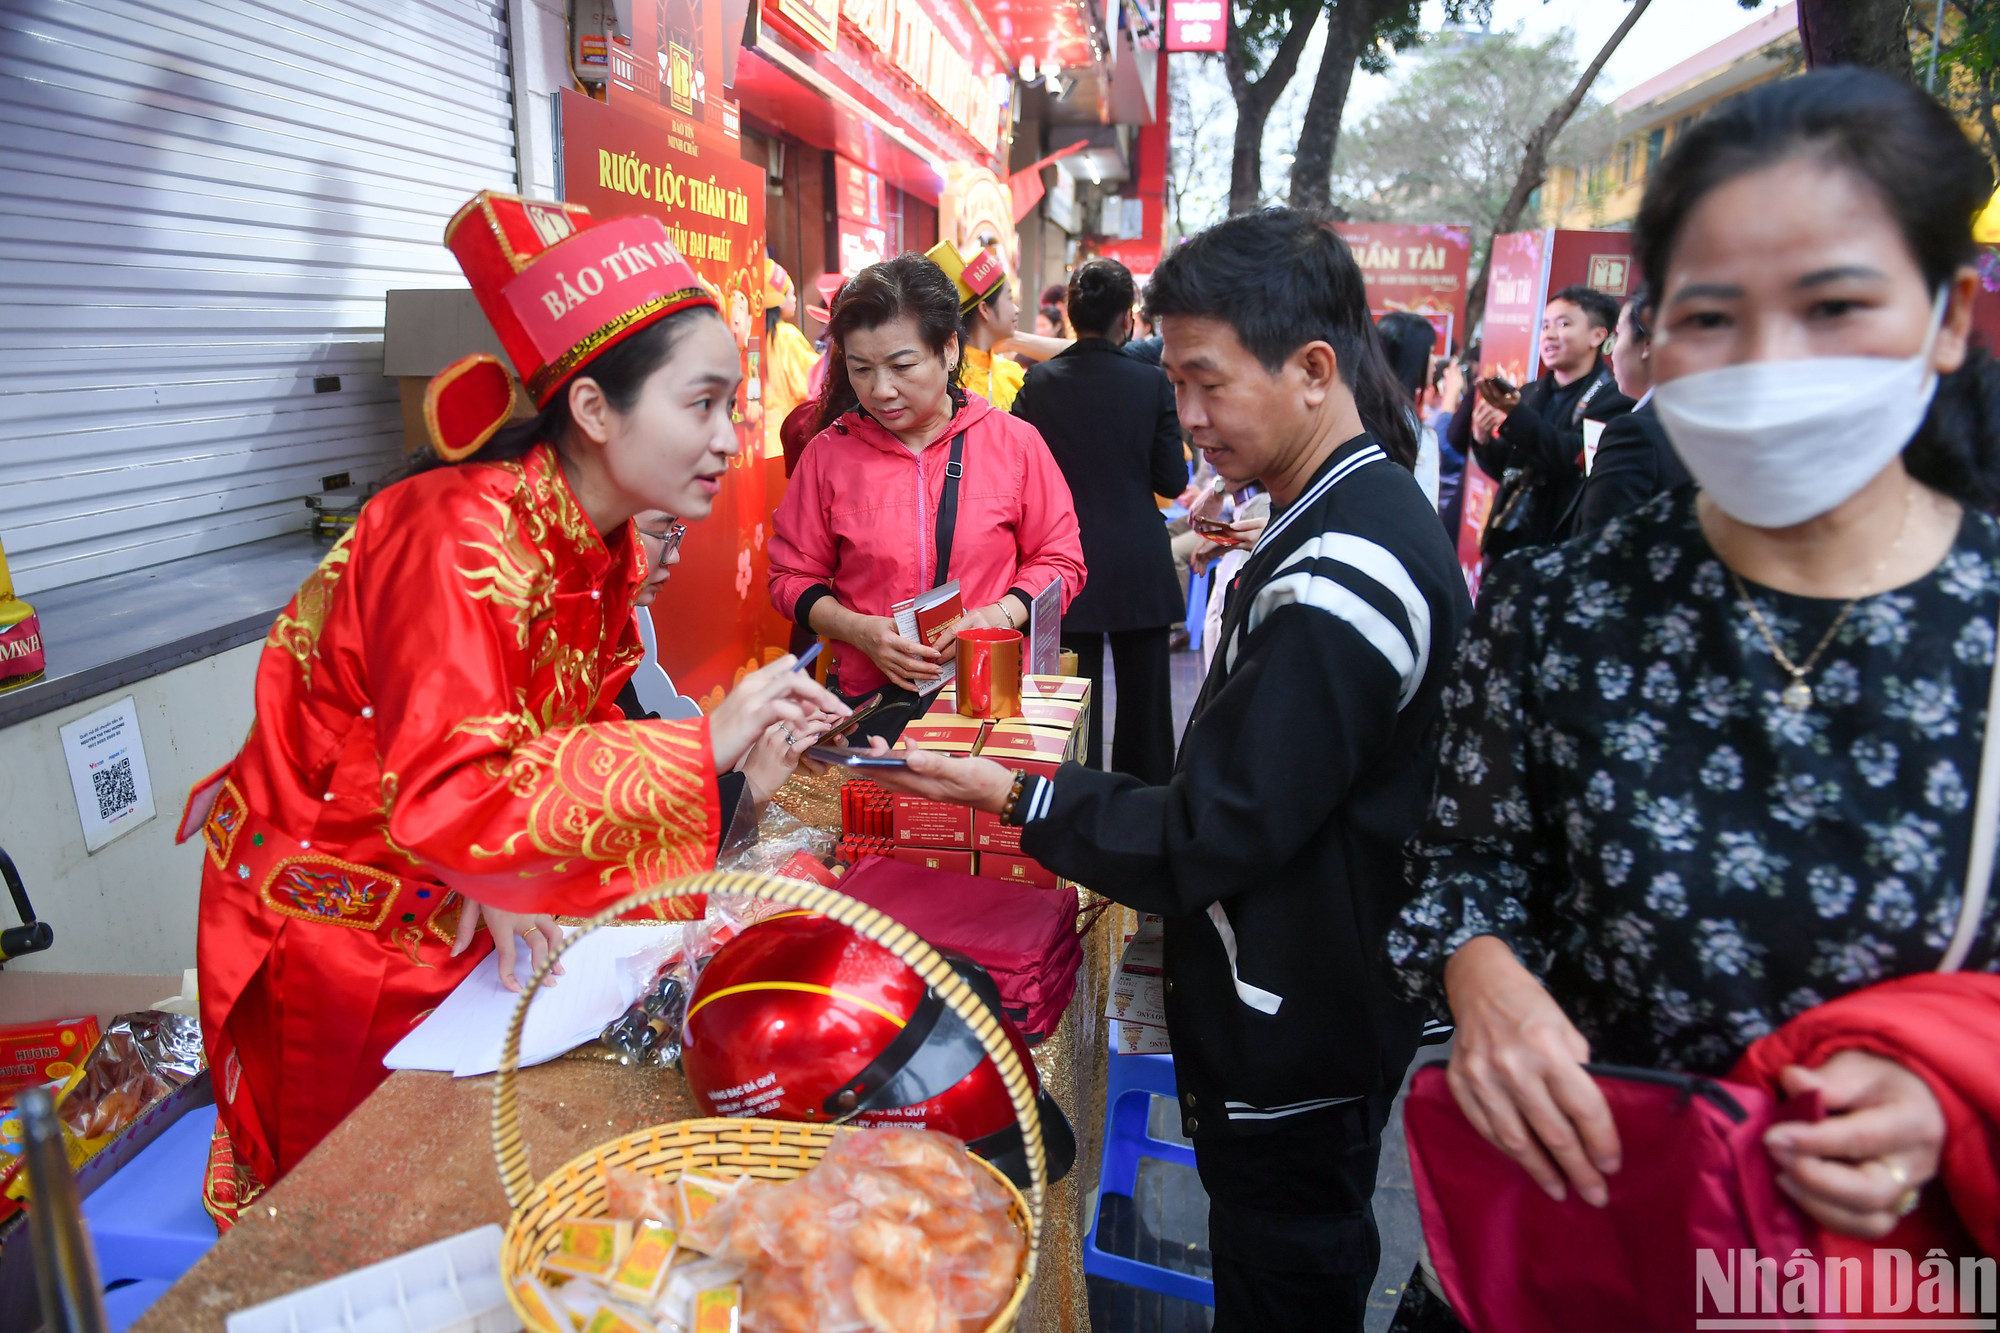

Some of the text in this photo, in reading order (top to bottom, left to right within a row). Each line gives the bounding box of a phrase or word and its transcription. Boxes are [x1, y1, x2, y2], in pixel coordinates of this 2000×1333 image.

[598, 148, 749, 226] RƯỚC LỘC THẦN TÀI
[689, 231, 707, 265] ĐẠI
[707, 230, 732, 264] PHÁT
[1351, 239, 1447, 270] HẦN TÀI
[540, 267, 605, 321] BẢO
[601, 241, 658, 283] TÍN
